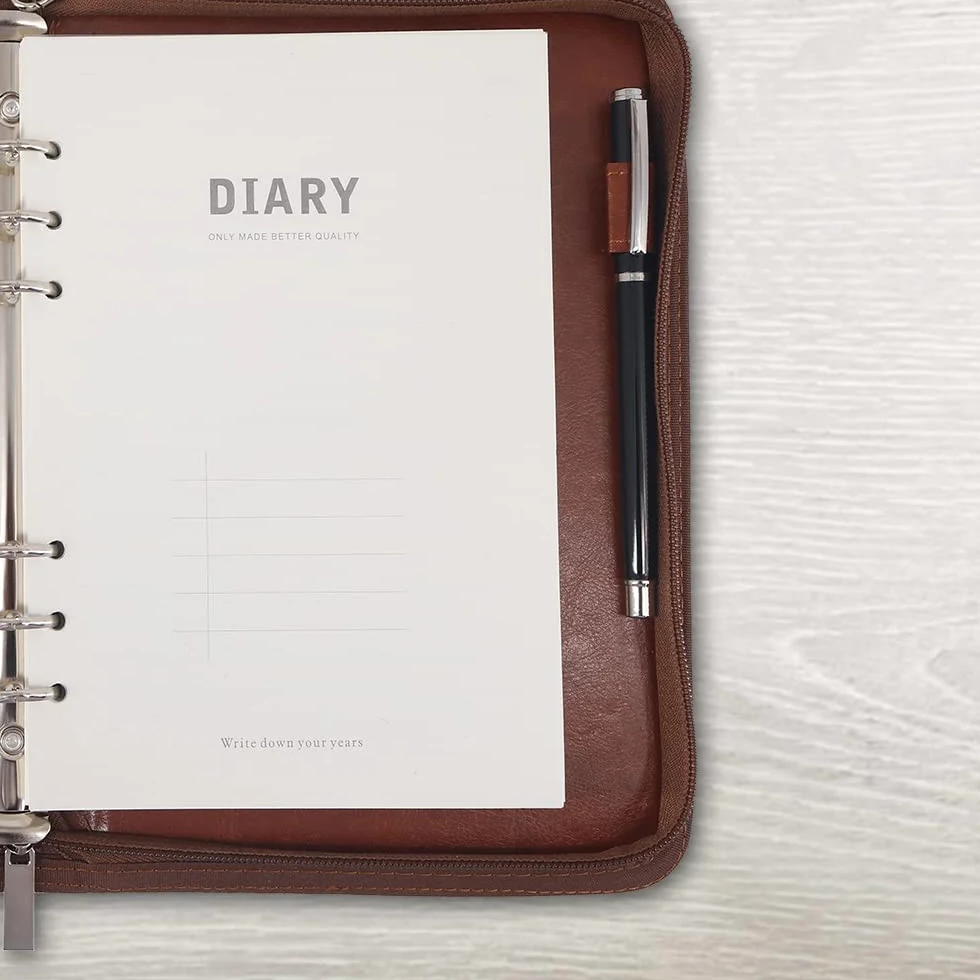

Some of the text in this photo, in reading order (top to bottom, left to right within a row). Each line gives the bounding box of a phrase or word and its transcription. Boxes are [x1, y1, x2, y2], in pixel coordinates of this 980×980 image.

[209, 177, 360, 215] DIARY
[208, 231, 360, 241] ONLY MADE BETTER QUALITY
[220, 737, 364, 751] Write down your years
